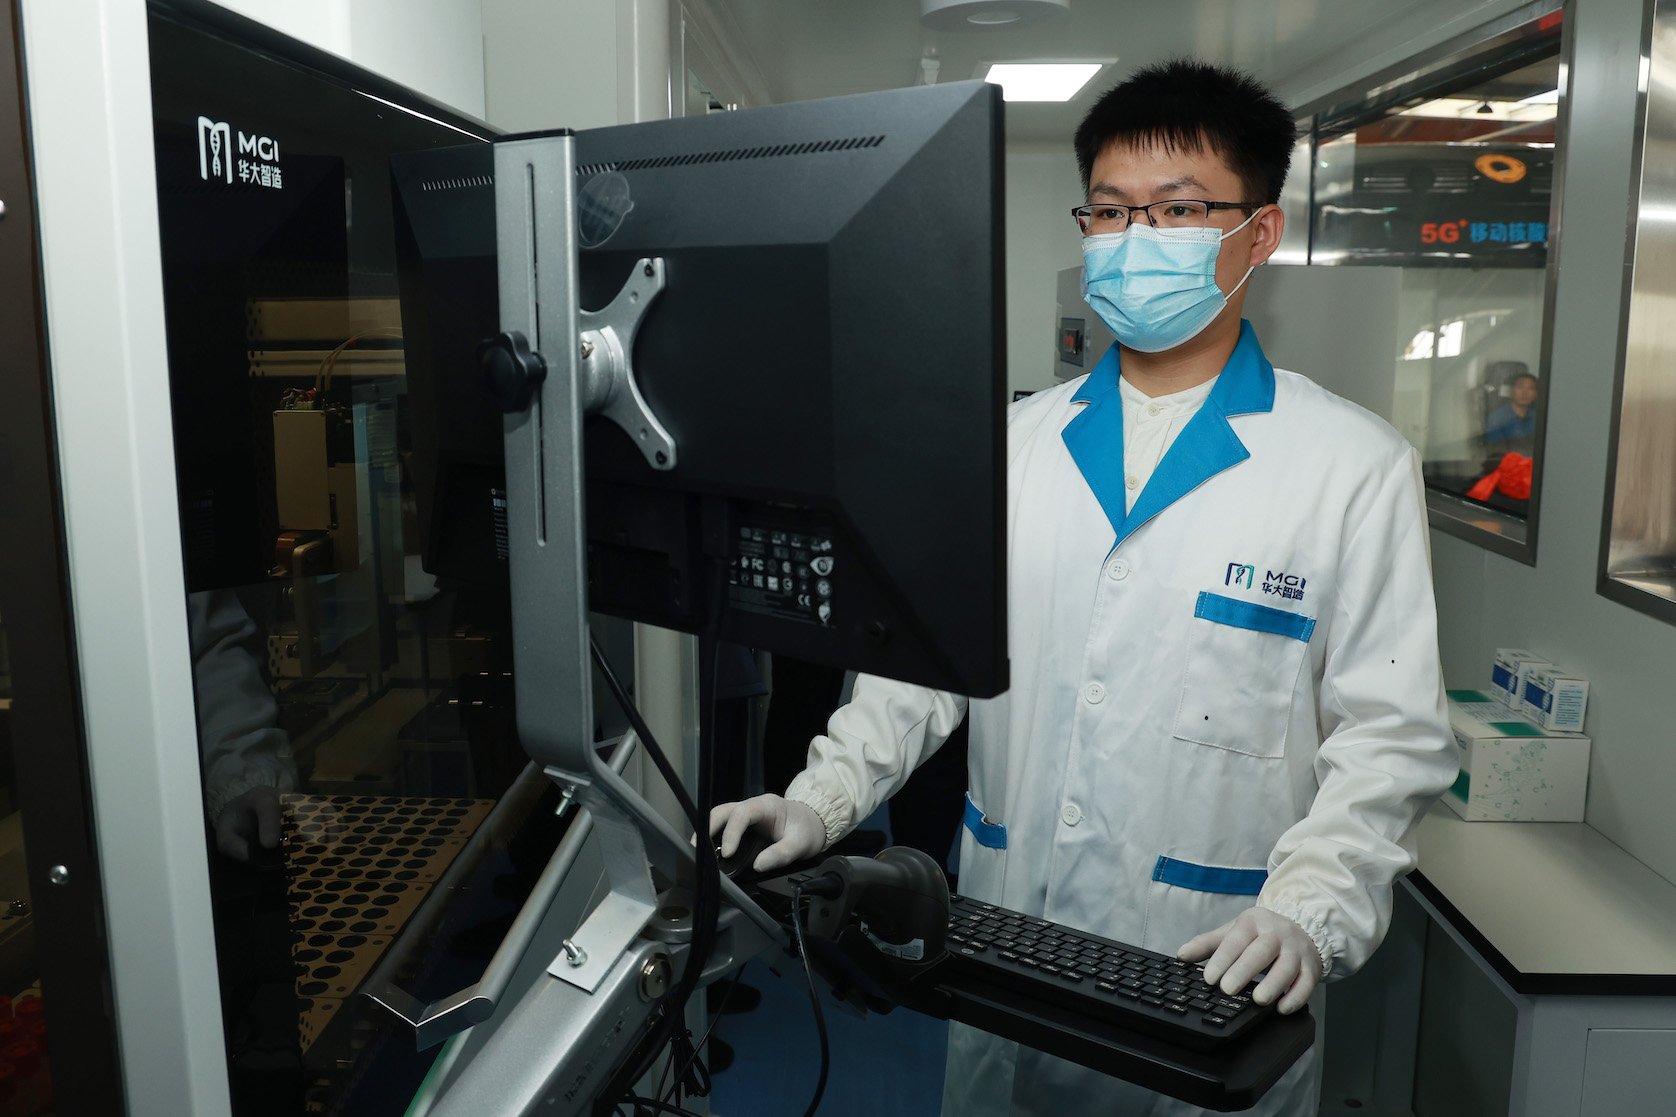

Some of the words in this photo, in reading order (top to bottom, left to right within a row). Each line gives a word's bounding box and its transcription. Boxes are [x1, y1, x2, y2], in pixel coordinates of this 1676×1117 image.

[238, 130, 279, 162] MGI
[238, 159, 282, 189] 华大智造
[1469, 222, 1549, 243] 移动核酸
[1266, 570, 1306, 589] MGI
[1261, 582, 1304, 601] 华大智造
